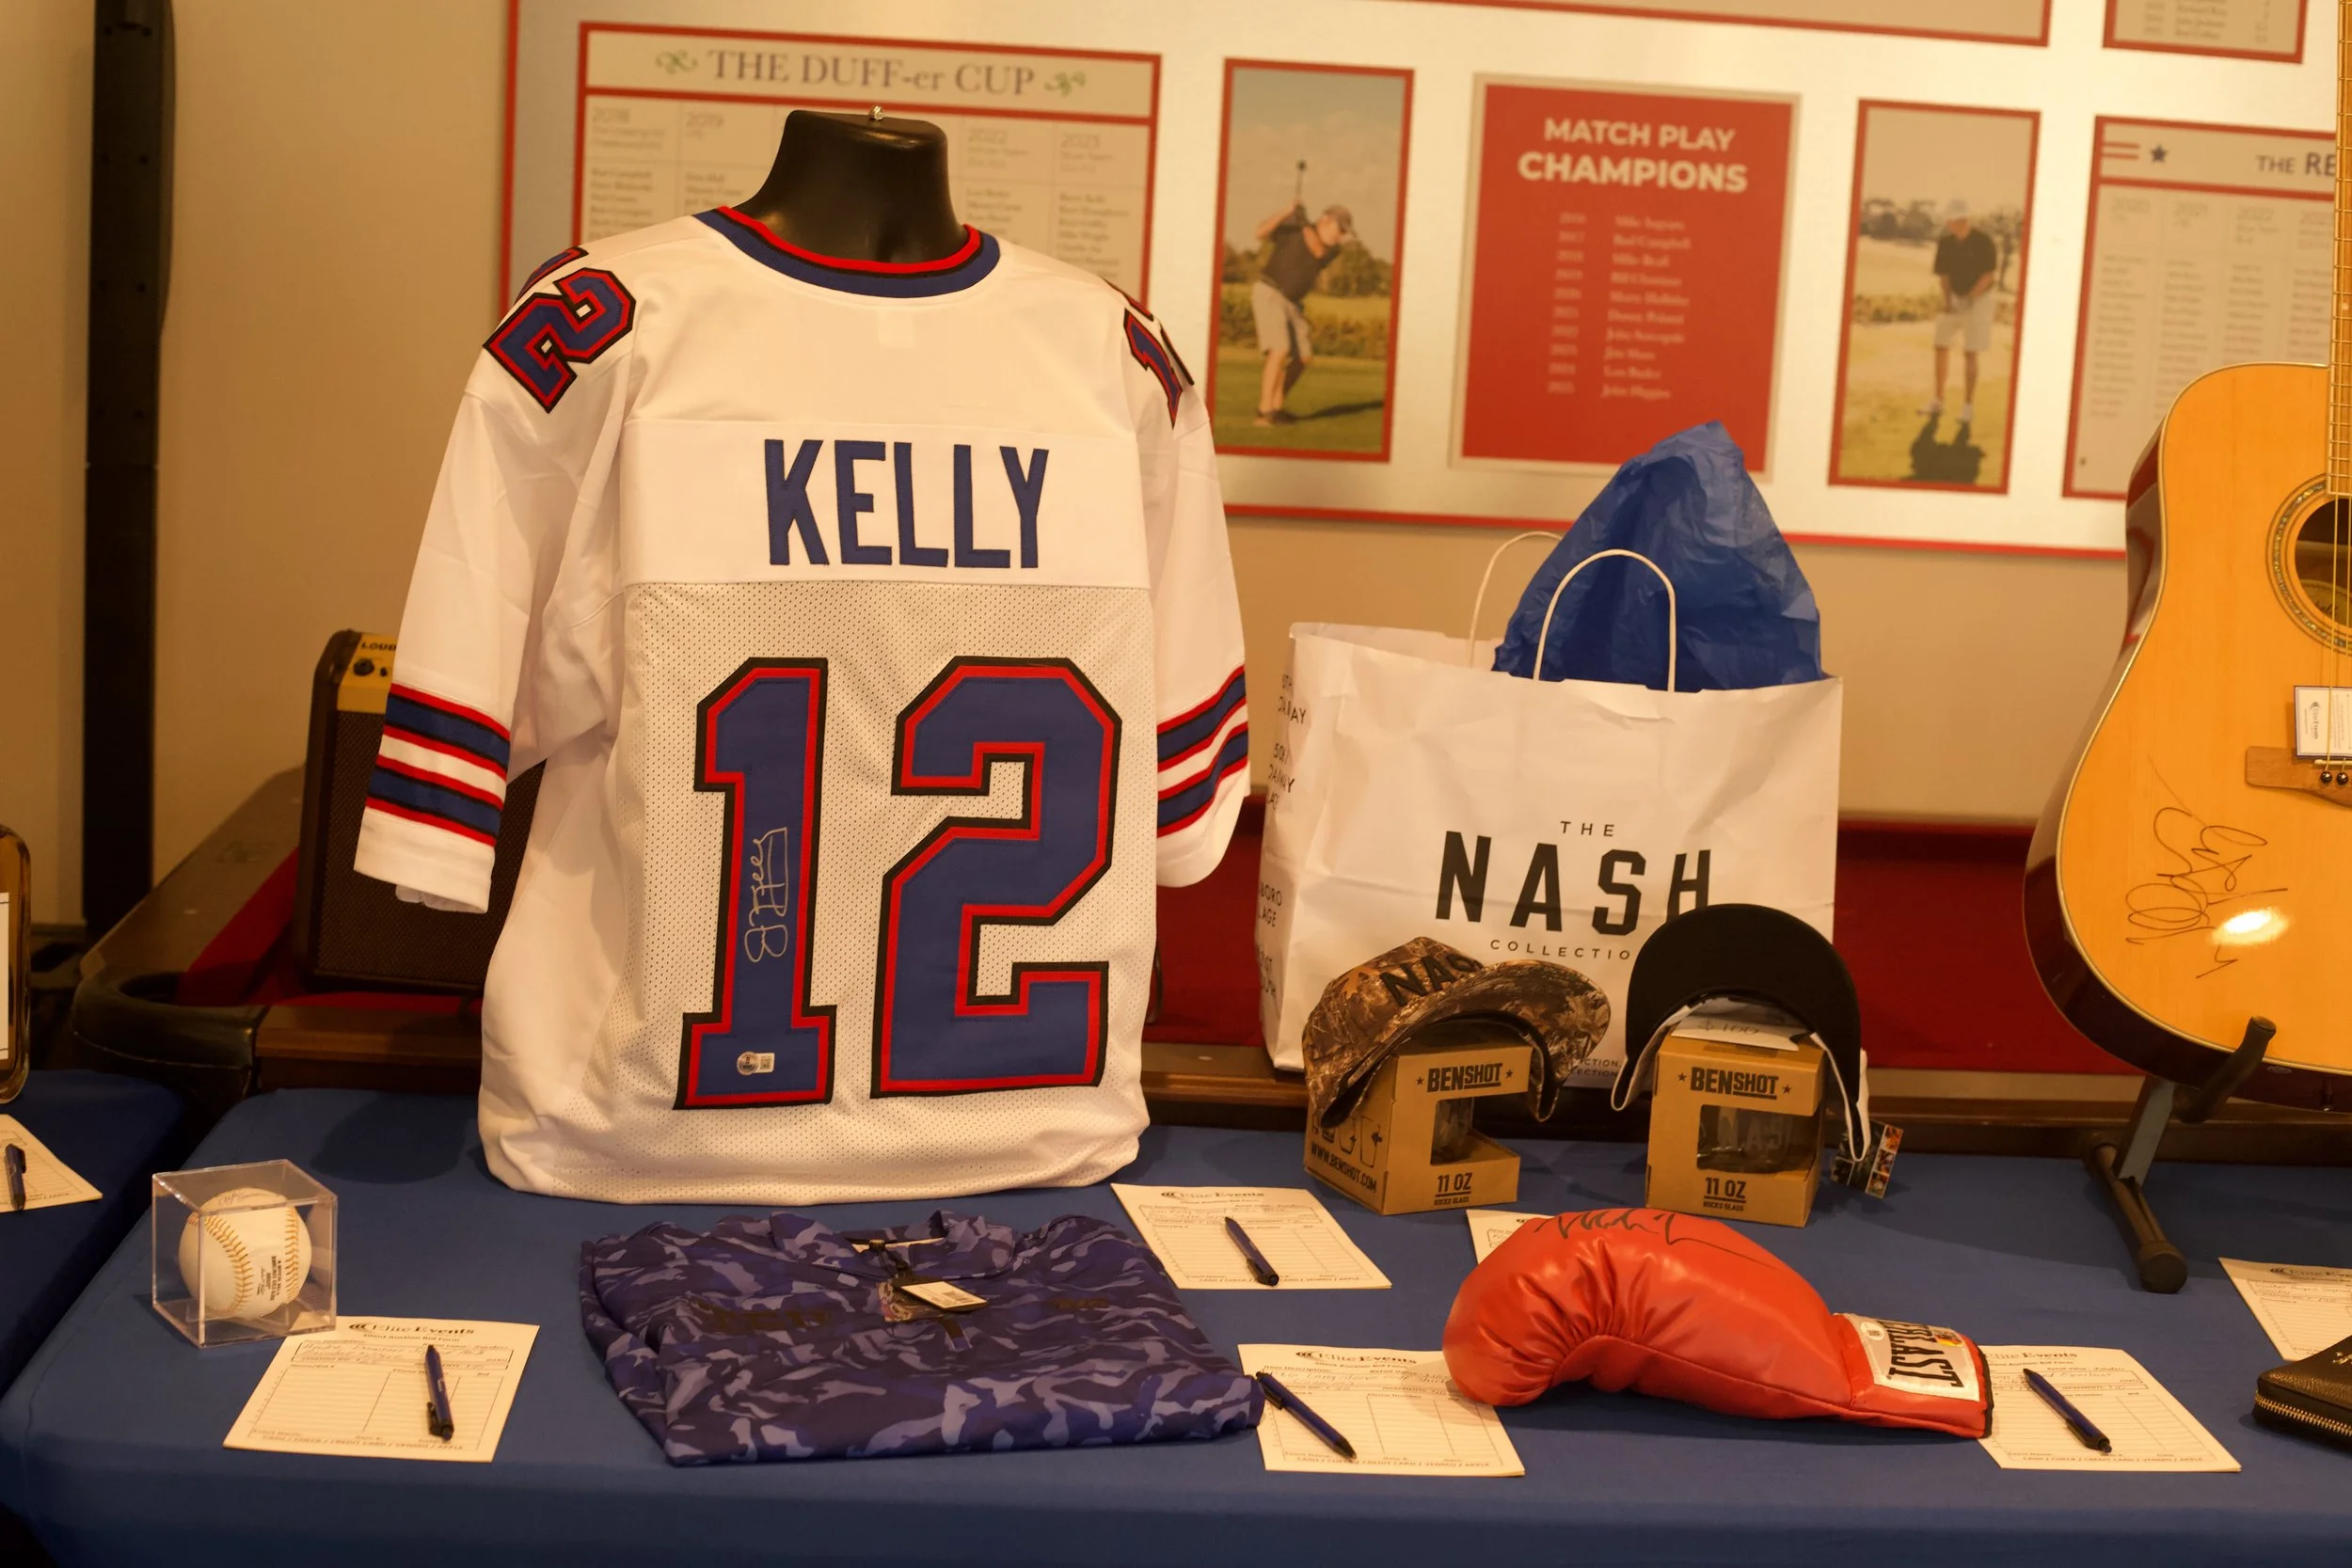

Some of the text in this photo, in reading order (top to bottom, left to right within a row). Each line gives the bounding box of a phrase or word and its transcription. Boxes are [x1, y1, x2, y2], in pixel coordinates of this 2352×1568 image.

[707, 49, 1035, 95] THE DUFF-er CUP
[1544, 117, 1737, 152] MATCH PLAY
[1518, 150, 1749, 194] CHAMPIONS
[2256, 153, 2296, 174] THE
[764, 438, 1050, 569] KELLY
[1560, 820, 1615, 837] THE
[672, 655, 1122, 1111] 12
[1436, 830, 1711, 937] NASH
[1489, 939, 1631, 960] COLLECTIO
[1425, 1063, 1503, 1094] BENSHOT
[1690, 1067, 1780, 1099] BENSHOT
[1311, 1143, 1378, 1195] WWW.BENSHOT.COM
[1437, 1172, 1474, 1194] 11 OZ
[1704, 1176, 1747, 1199] 11 OZ
[415, 1326, 475, 1335] Events
[1359, 1355, 1417, 1364] Events
